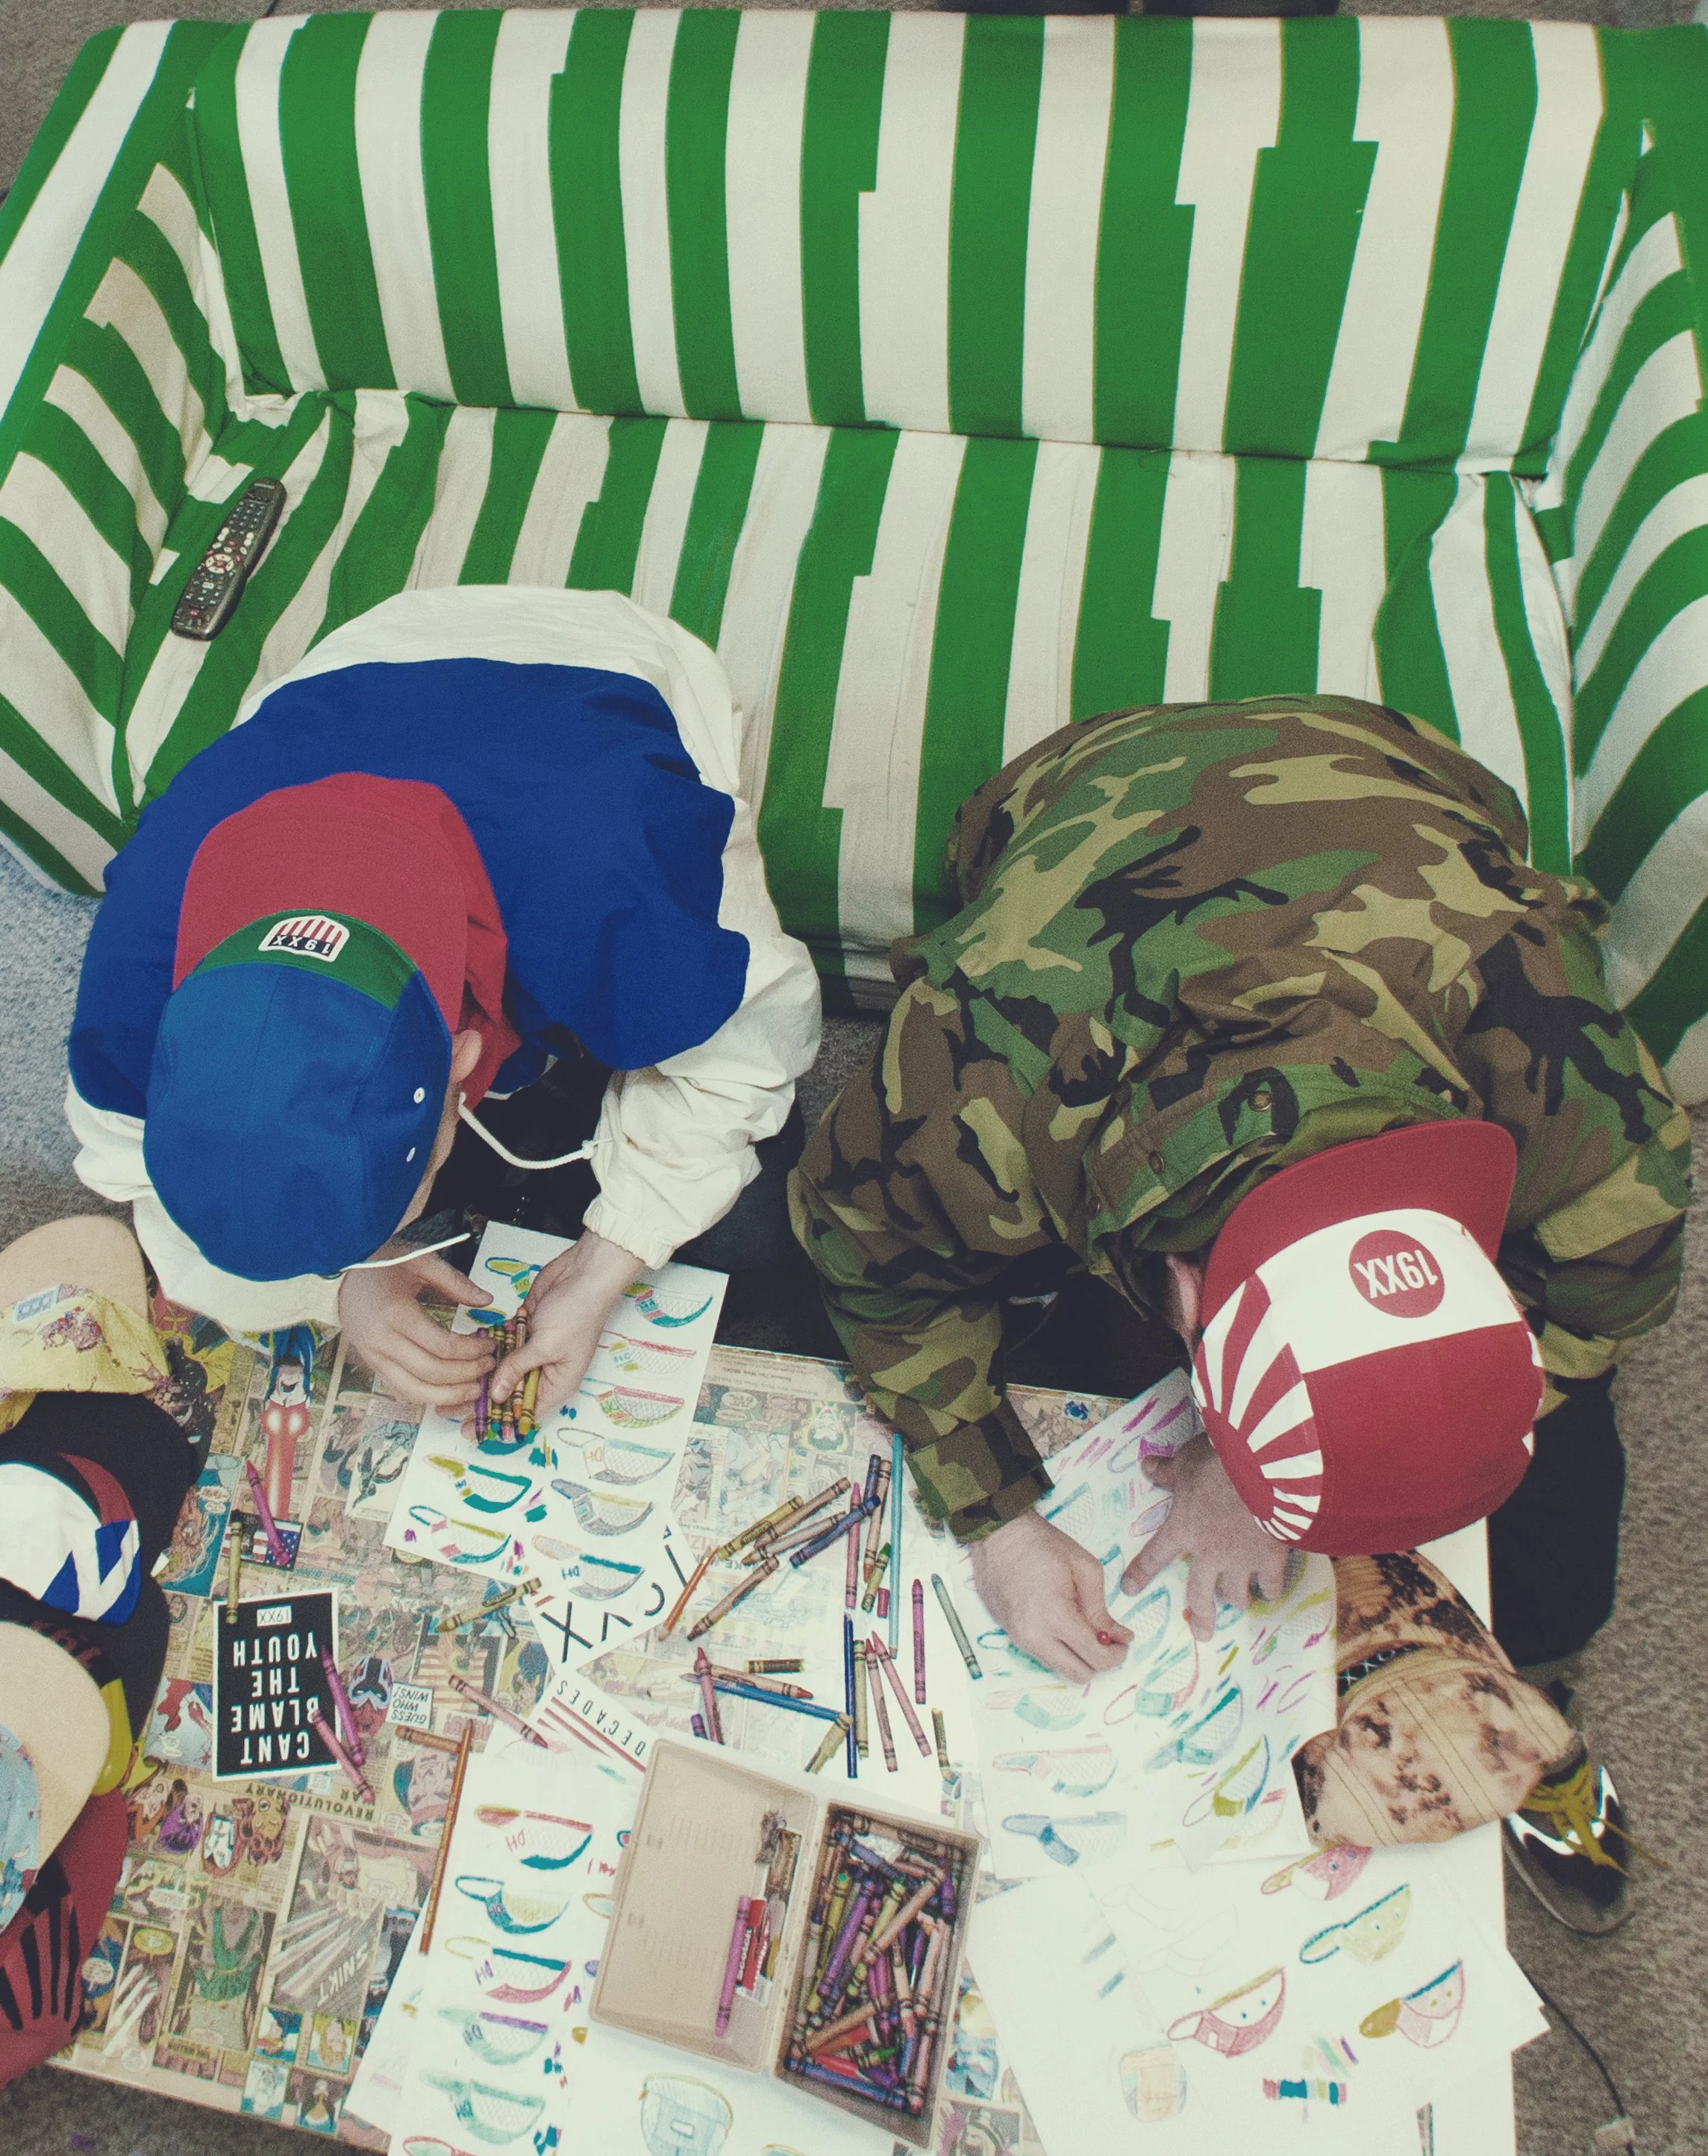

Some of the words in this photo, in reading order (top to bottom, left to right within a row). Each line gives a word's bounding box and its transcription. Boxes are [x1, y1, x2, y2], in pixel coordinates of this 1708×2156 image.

[272, 935, 332, 954] 19XX
[1354, 1249, 1438, 1299] 19XX
[562, 1566, 579, 1581] DH
[257, 1607, 290, 1624] 19XX
[233, 1632, 317, 1666] YOUTH
[251, 1666, 299, 1697] THE
[392, 1699, 419, 1711] WHO
[393, 1687, 429, 1702] WINS!
[231, 1696, 319, 1732] BLAME
[391, 1710, 427, 1725] GUESS
[240, 1731, 310, 1765] CANT
[245, 1783, 374, 1821] REVOLUTIONARY
[506, 1829, 525, 1852] DH
[316, 1941, 369, 2005] SNIKT
[475, 1960, 493, 1984] DH
